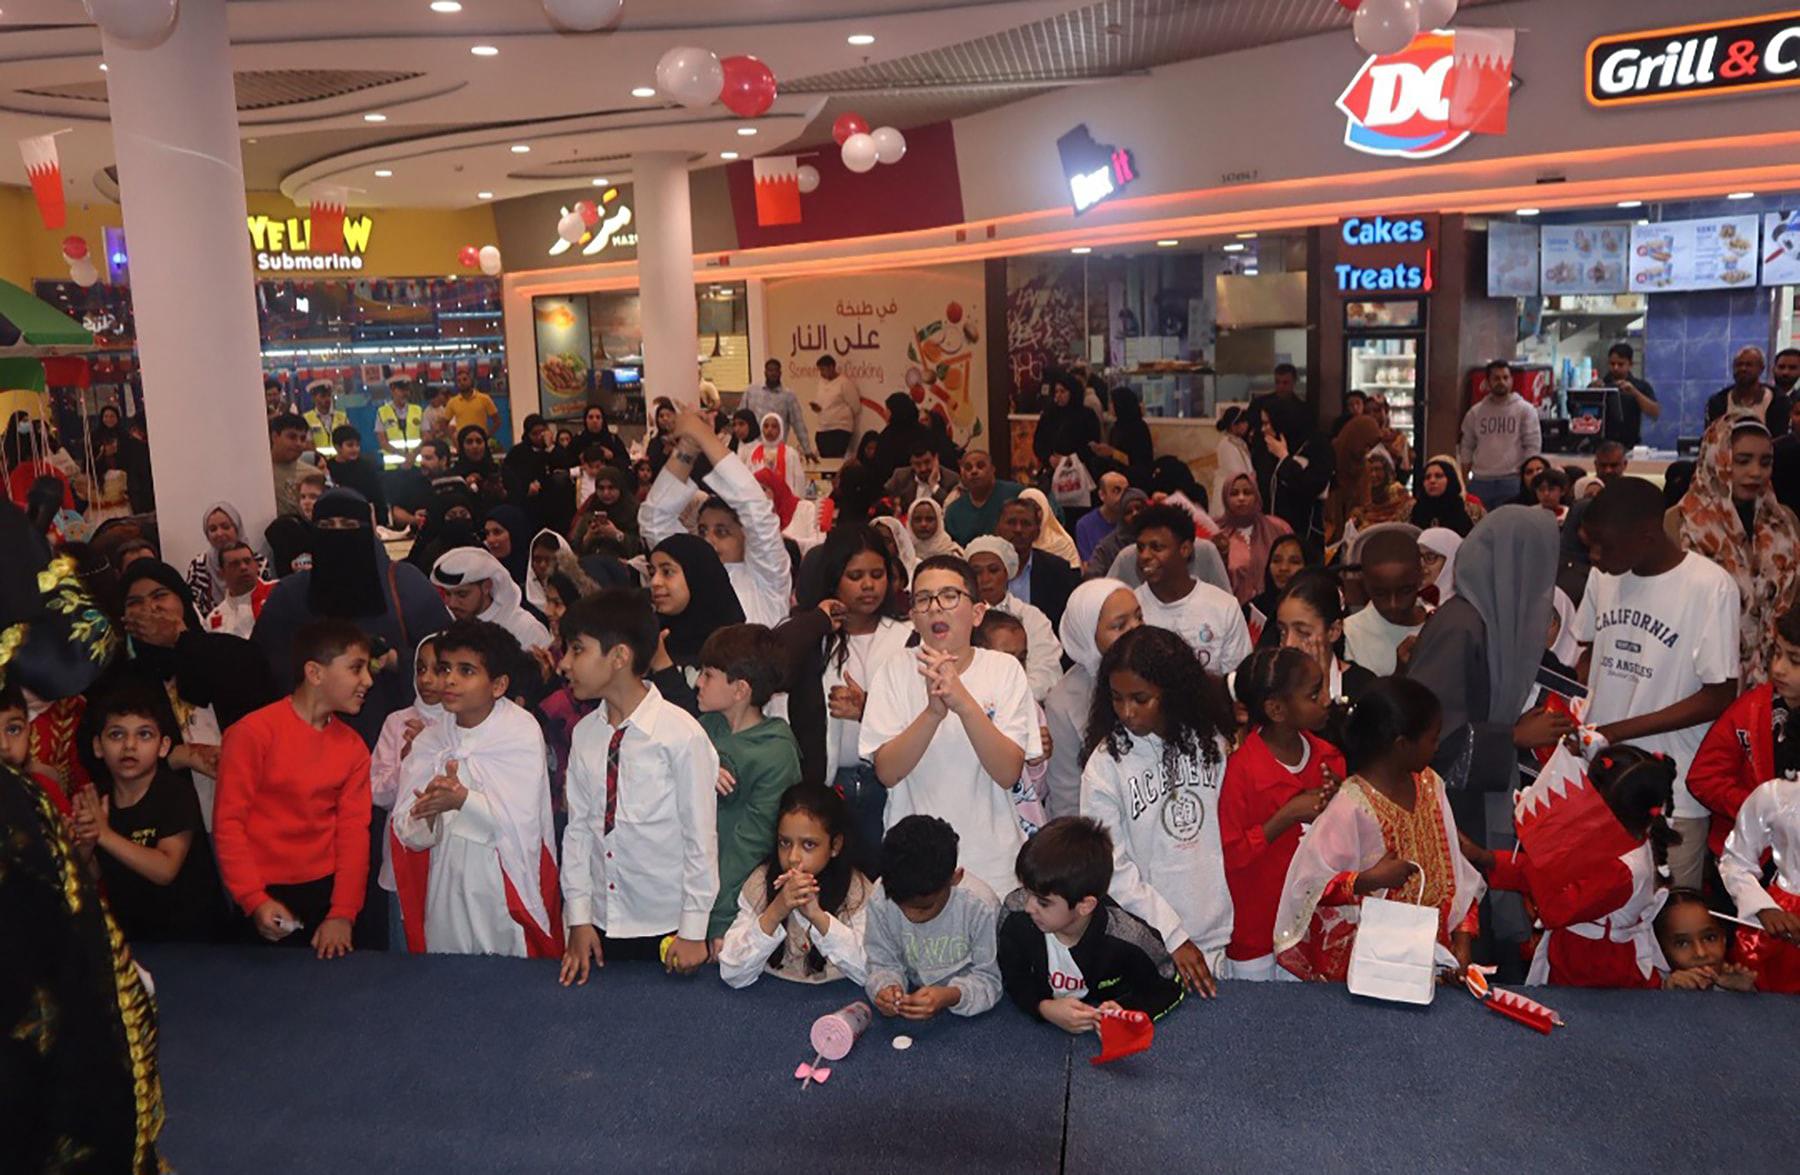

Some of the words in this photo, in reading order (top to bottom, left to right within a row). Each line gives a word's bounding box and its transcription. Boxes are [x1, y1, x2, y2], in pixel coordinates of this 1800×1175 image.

[1599, 36, 1719, 94] Grill
[1719, 40, 1759, 79] &
[1342, 215, 1424, 245] Cakes
[257, 252, 363, 270] Submarine
[1334, 262, 1422, 291] Treats
[875, 297, 898, 322] في
[790, 323, 828, 357] النار
[833, 322, 880, 357] على
[1480, 416, 1516, 435] SOHO
[1595, 608, 1680, 649] CALIFORNIA
